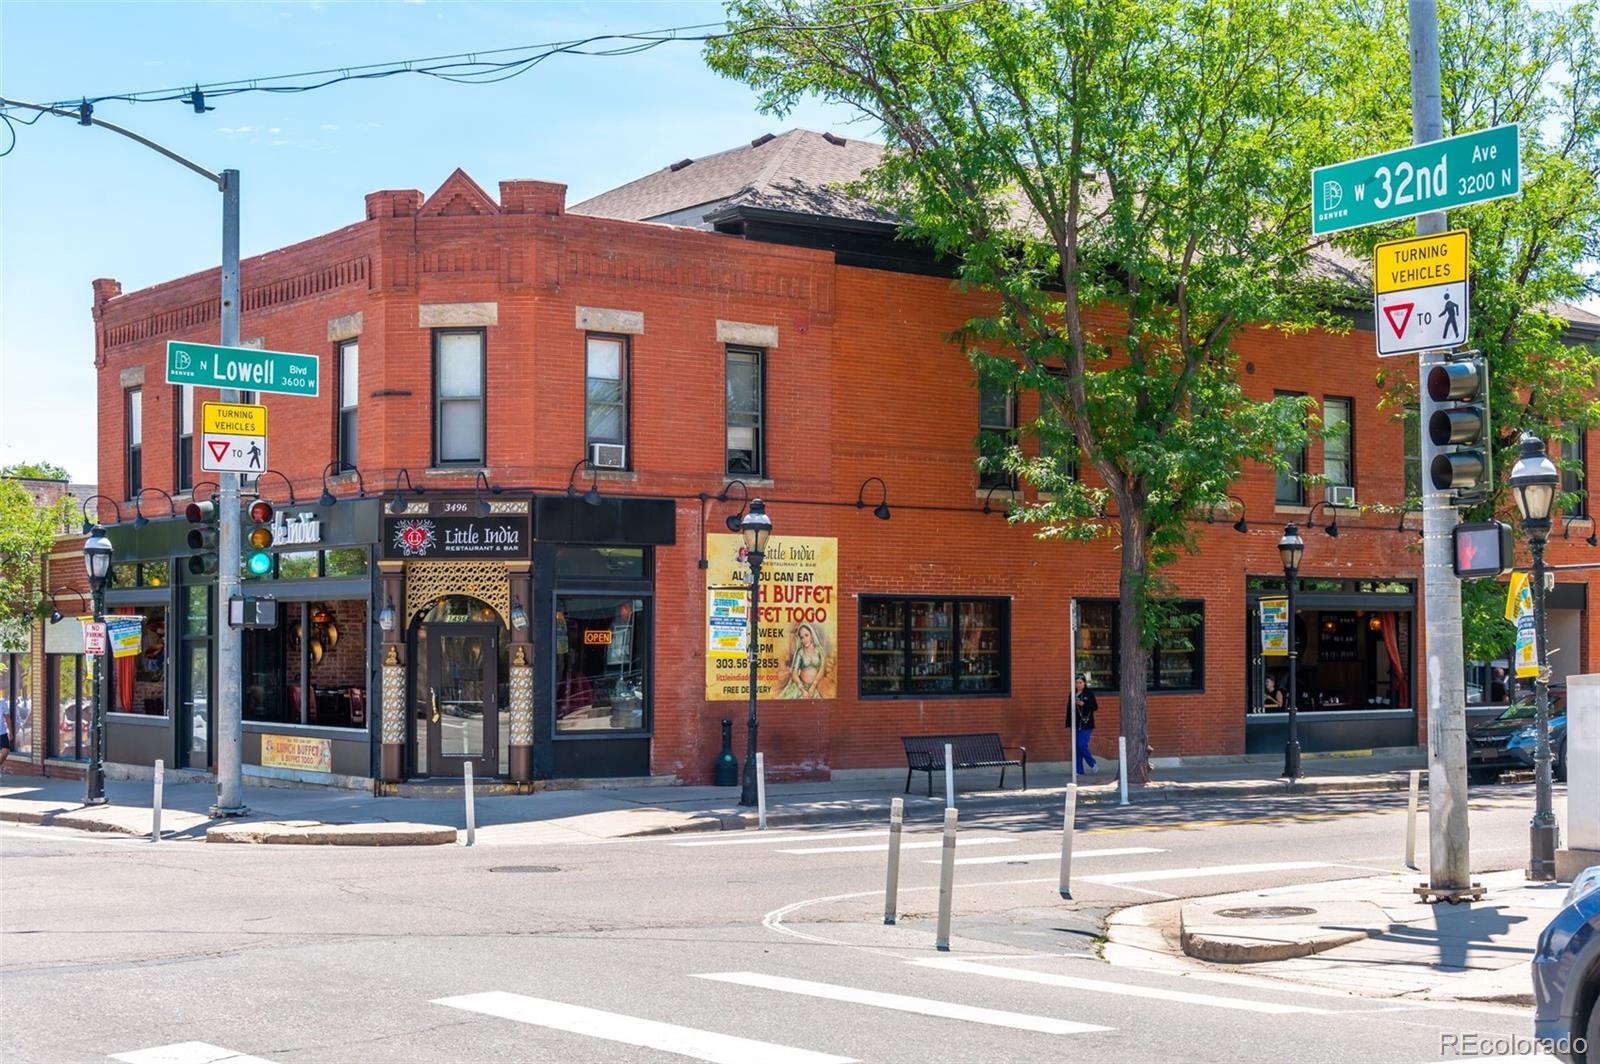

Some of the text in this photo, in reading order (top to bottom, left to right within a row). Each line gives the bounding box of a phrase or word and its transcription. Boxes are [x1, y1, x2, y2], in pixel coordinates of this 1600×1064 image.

[1472, 144, 1497, 164] Ave
[1354, 153, 1448, 209] W 32nd
[1458, 168, 1512, 196] 3200 N
[1318, 208, 1349, 221] DENVER
[1394, 243, 1448, 264] TURNING
[1391, 263, 1451, 284] VEHICLES
[1416, 311, 1432, 326] TO
[170, 369, 195, 377] DENVER
[200, 353, 274, 384] N Lowell
[289, 365, 307, 376] Blvd
[281, 377, 316, 389] 3600 W
[217, 409, 254, 419] TURNING
[215, 421, 256, 432] VEHICLES
[232, 449, 243, 458] TO
[444, 503, 468, 512] 3496
[444, 523, 519, 544] Little India
[790, 544, 815, 561] India
[774, 572, 793, 582] CAN
[797, 573, 814, 582] EAT
[774, 585, 833, 604] BUFFET
[785, 607, 827, 623] TOGO
[587, 633, 609, 642] OPEN
[759, 628, 784, 638] WEEK
[723, 686, 739, 694] FREE
